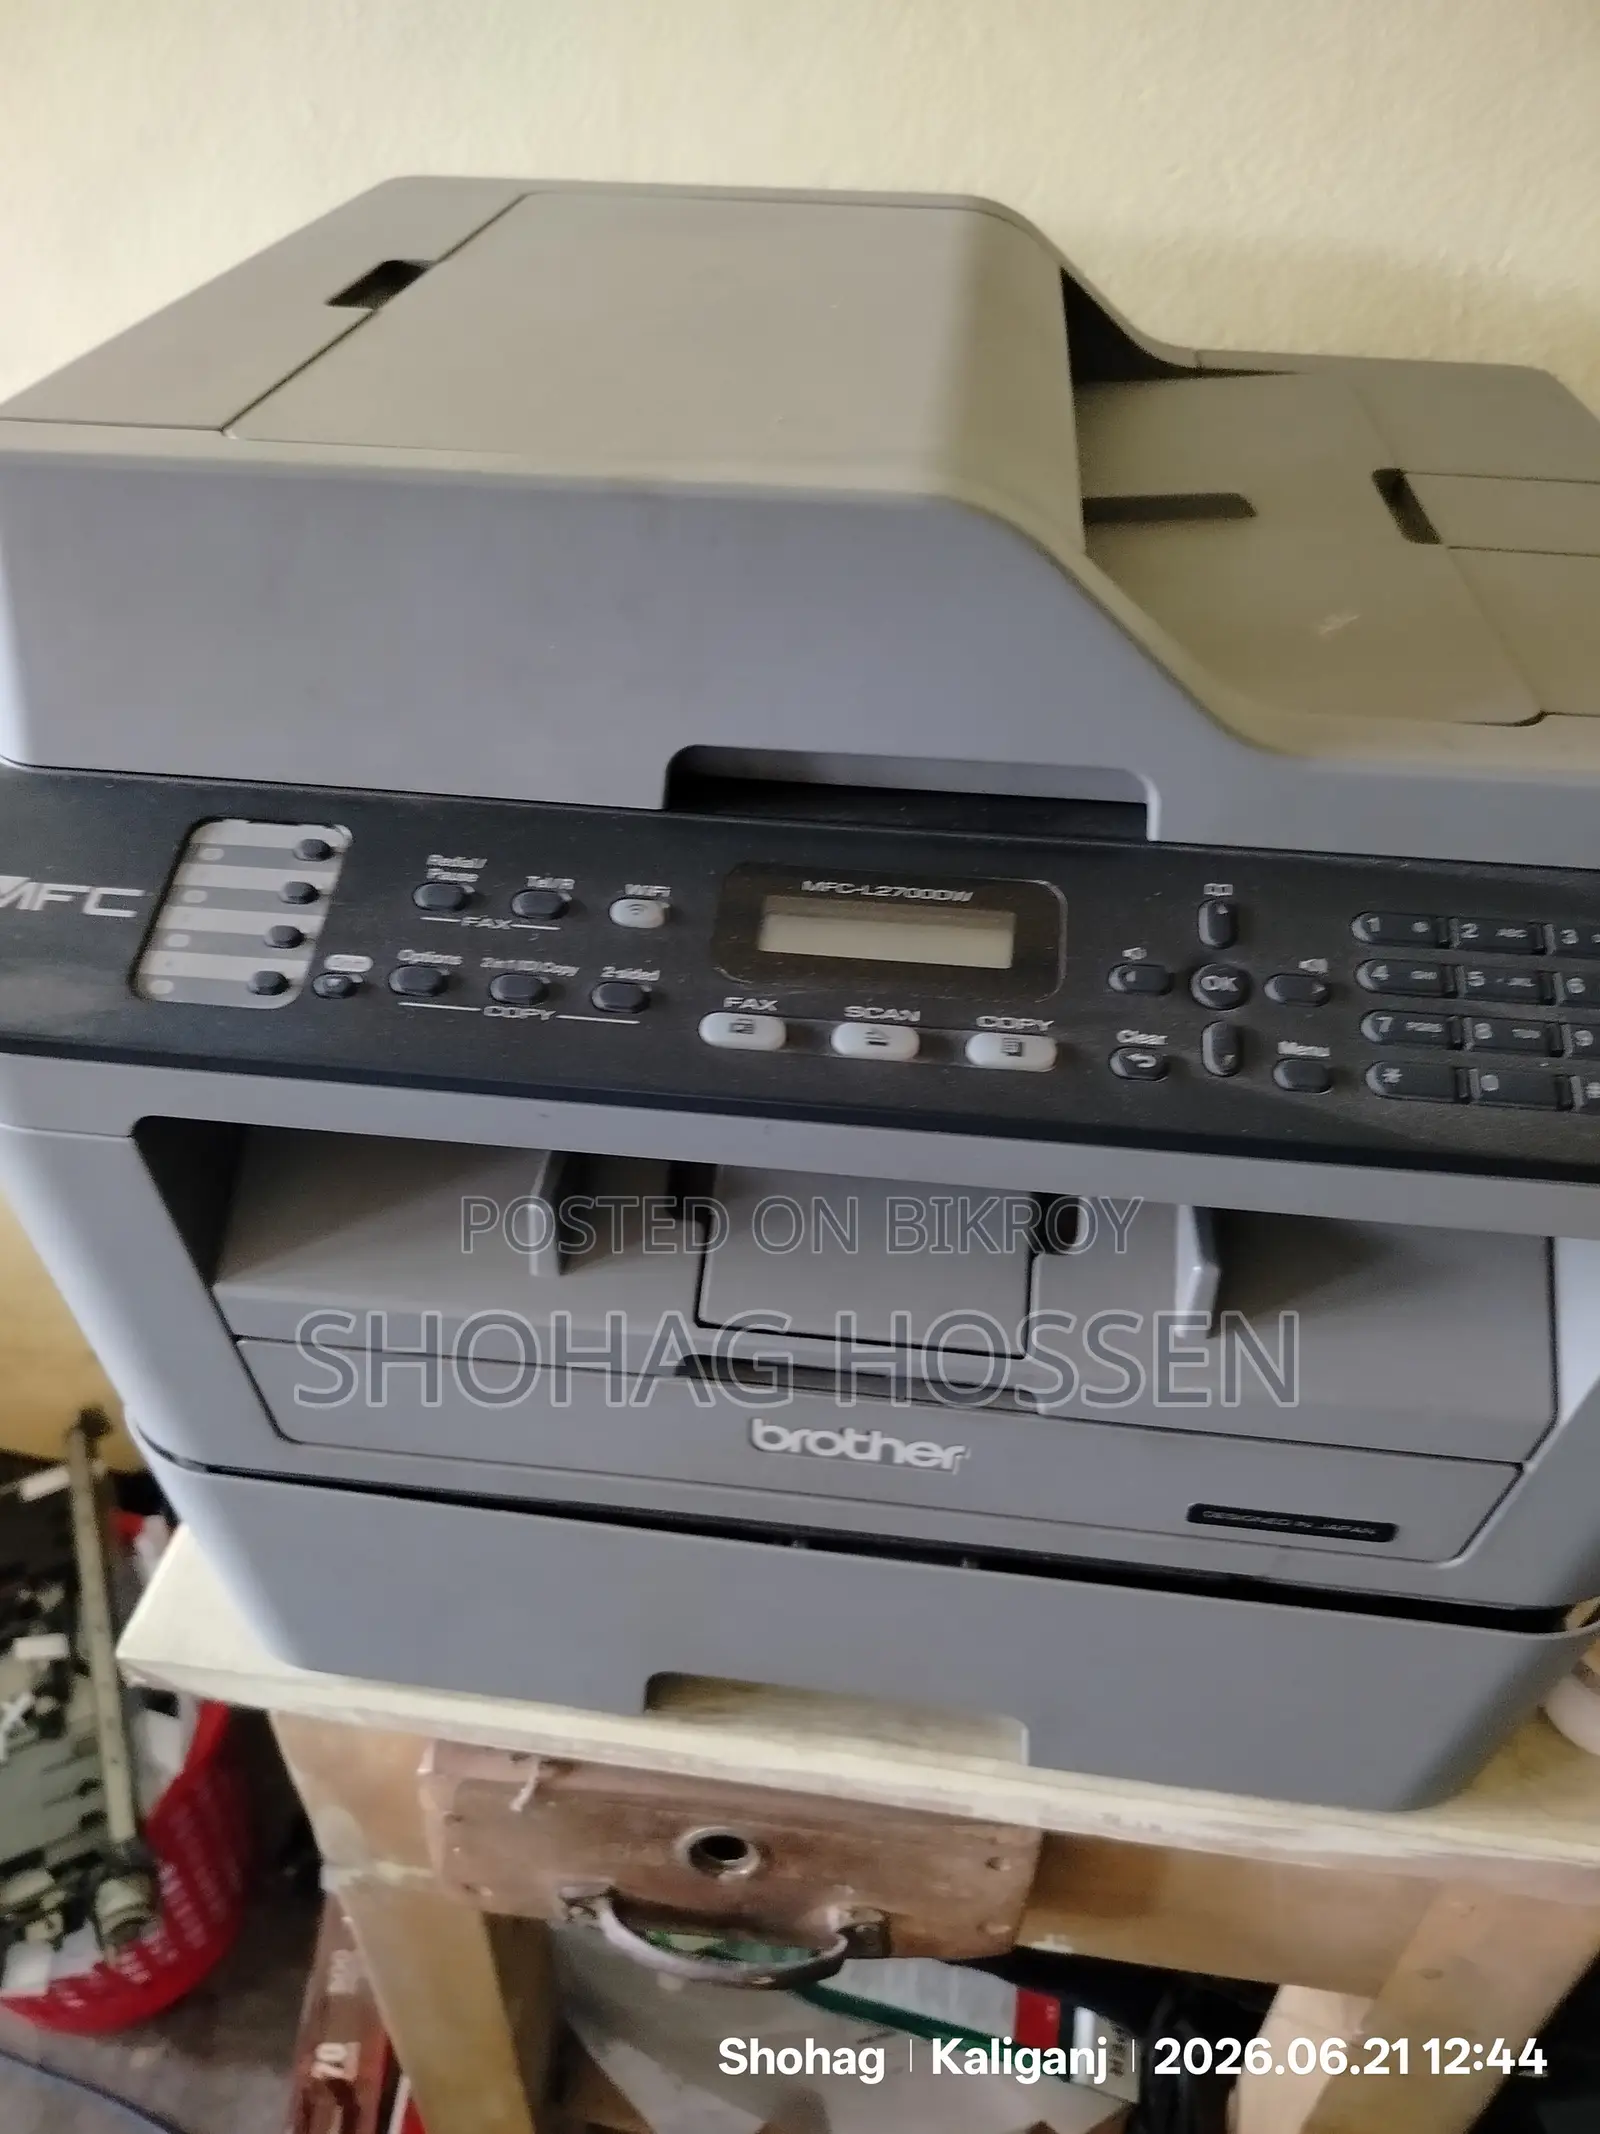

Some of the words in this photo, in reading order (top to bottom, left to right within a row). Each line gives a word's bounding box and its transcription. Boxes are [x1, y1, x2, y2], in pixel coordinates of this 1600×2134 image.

[0, 875, 146, 918] MFC
[1366, 916, 1381, 933] 1
[1460, 922, 1480, 939] 2
[1560, 928, 1579, 945] 3
[1371, 965, 1390, 981] 4
[1467, 970, 1486, 987] 5
[1201, 975, 1239, 992] OK
[724, 997, 778, 1011] FAX
[844, 1006, 921, 1022] SCAN
[976, 1015, 1055, 1032] COPY
[1375, 1016, 1394, 1033] 7
[752, 1418, 968, 1471] brother
